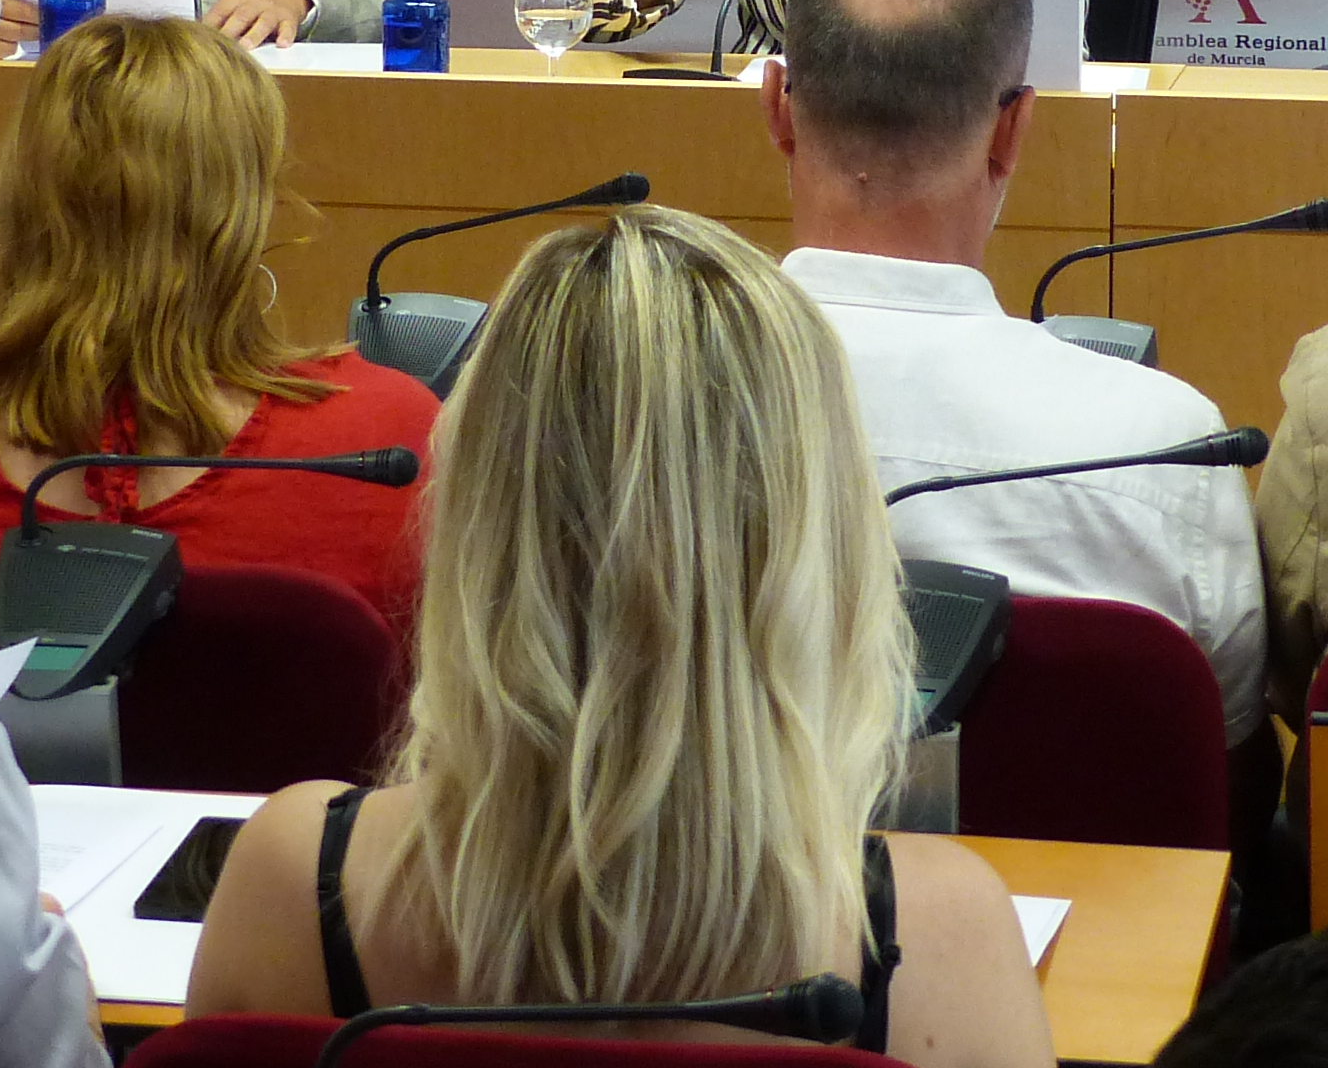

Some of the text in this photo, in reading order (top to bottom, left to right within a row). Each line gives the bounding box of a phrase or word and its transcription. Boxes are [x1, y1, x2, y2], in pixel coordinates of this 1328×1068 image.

[1155, 33, 1328, 51] amblea Regional
[1187, 53, 1267, 66] de Murcia
